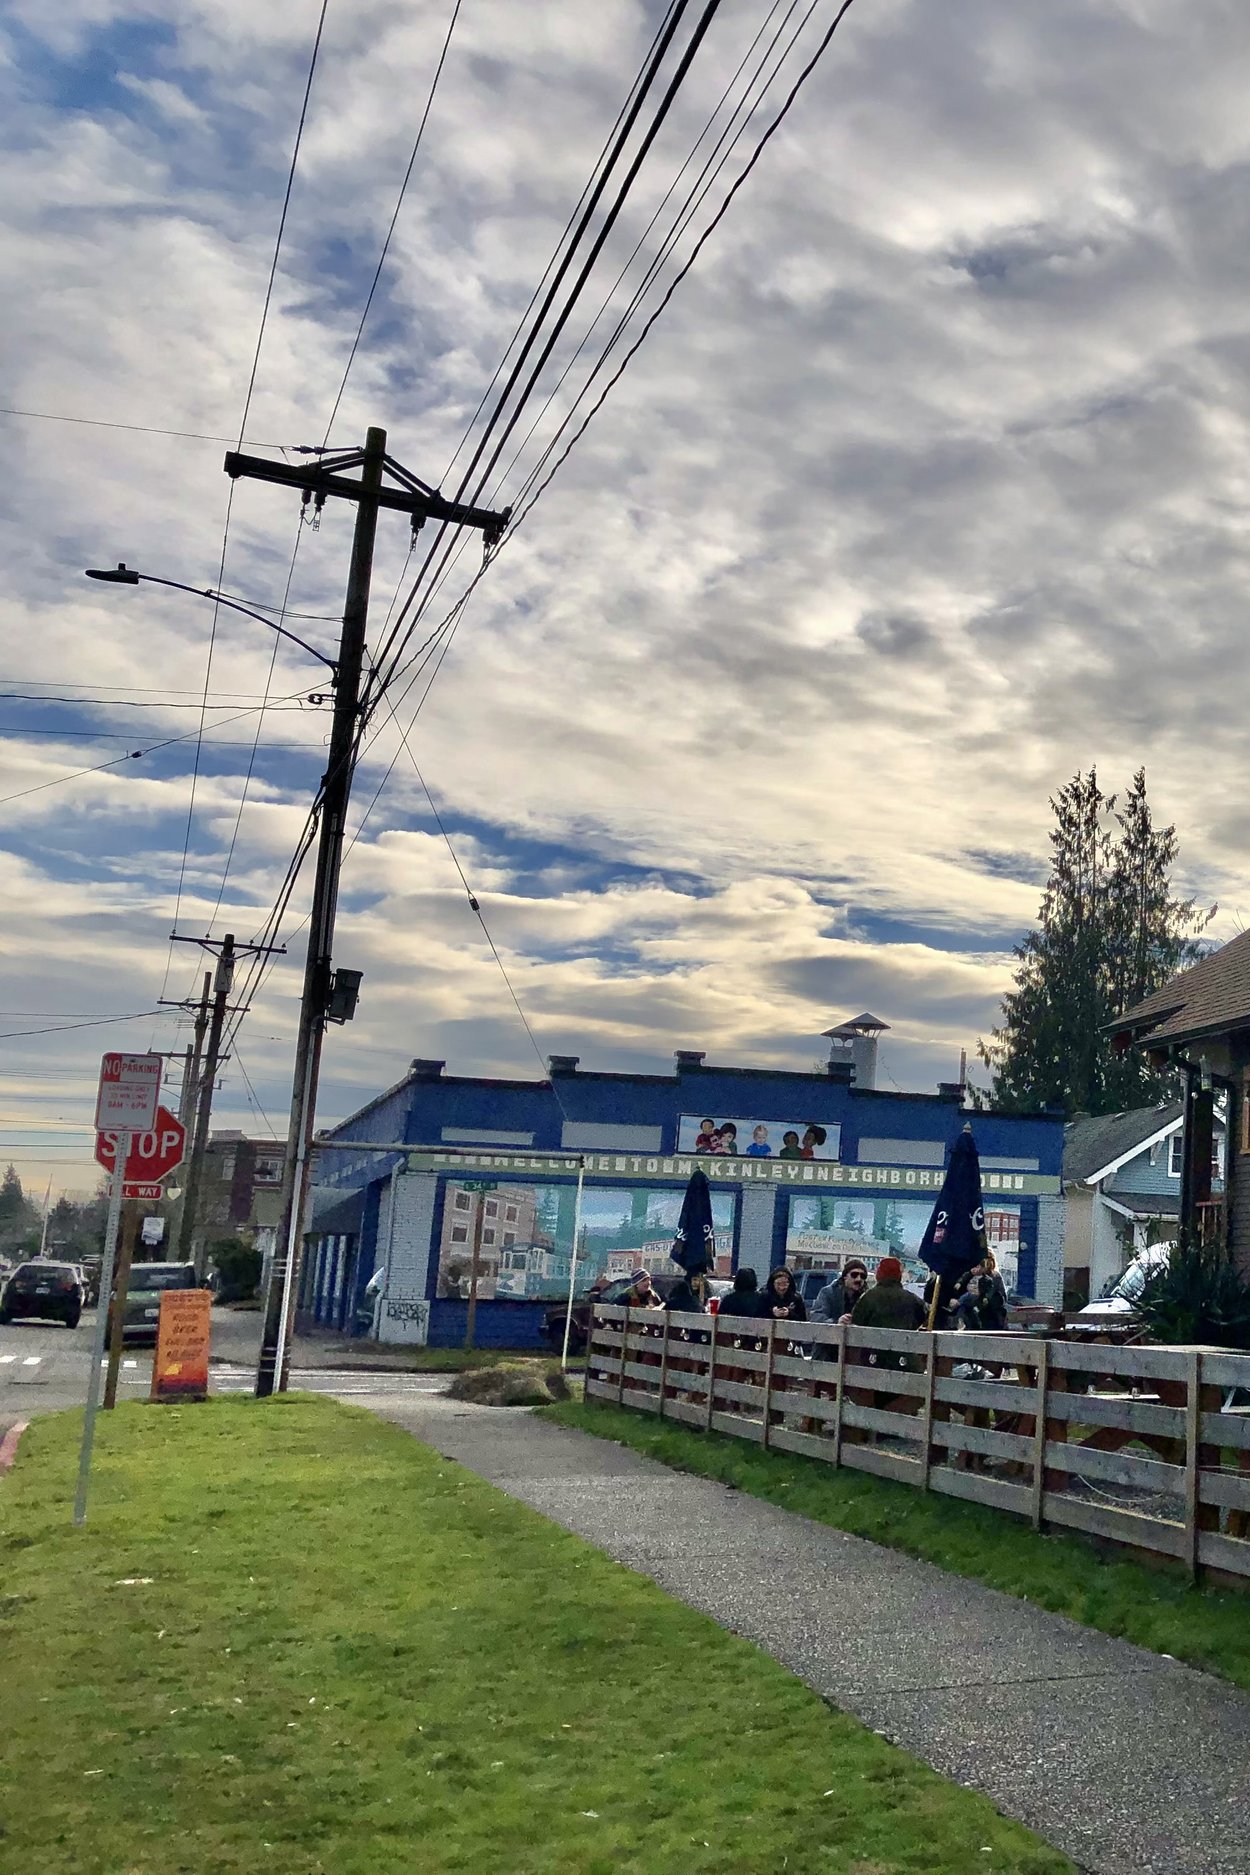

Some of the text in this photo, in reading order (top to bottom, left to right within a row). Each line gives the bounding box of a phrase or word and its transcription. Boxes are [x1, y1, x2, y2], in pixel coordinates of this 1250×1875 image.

[103, 1060, 159, 1075] NO PARKING
[631, 1157, 657, 1172] TO
[138, 1187, 158, 1198] WAY
